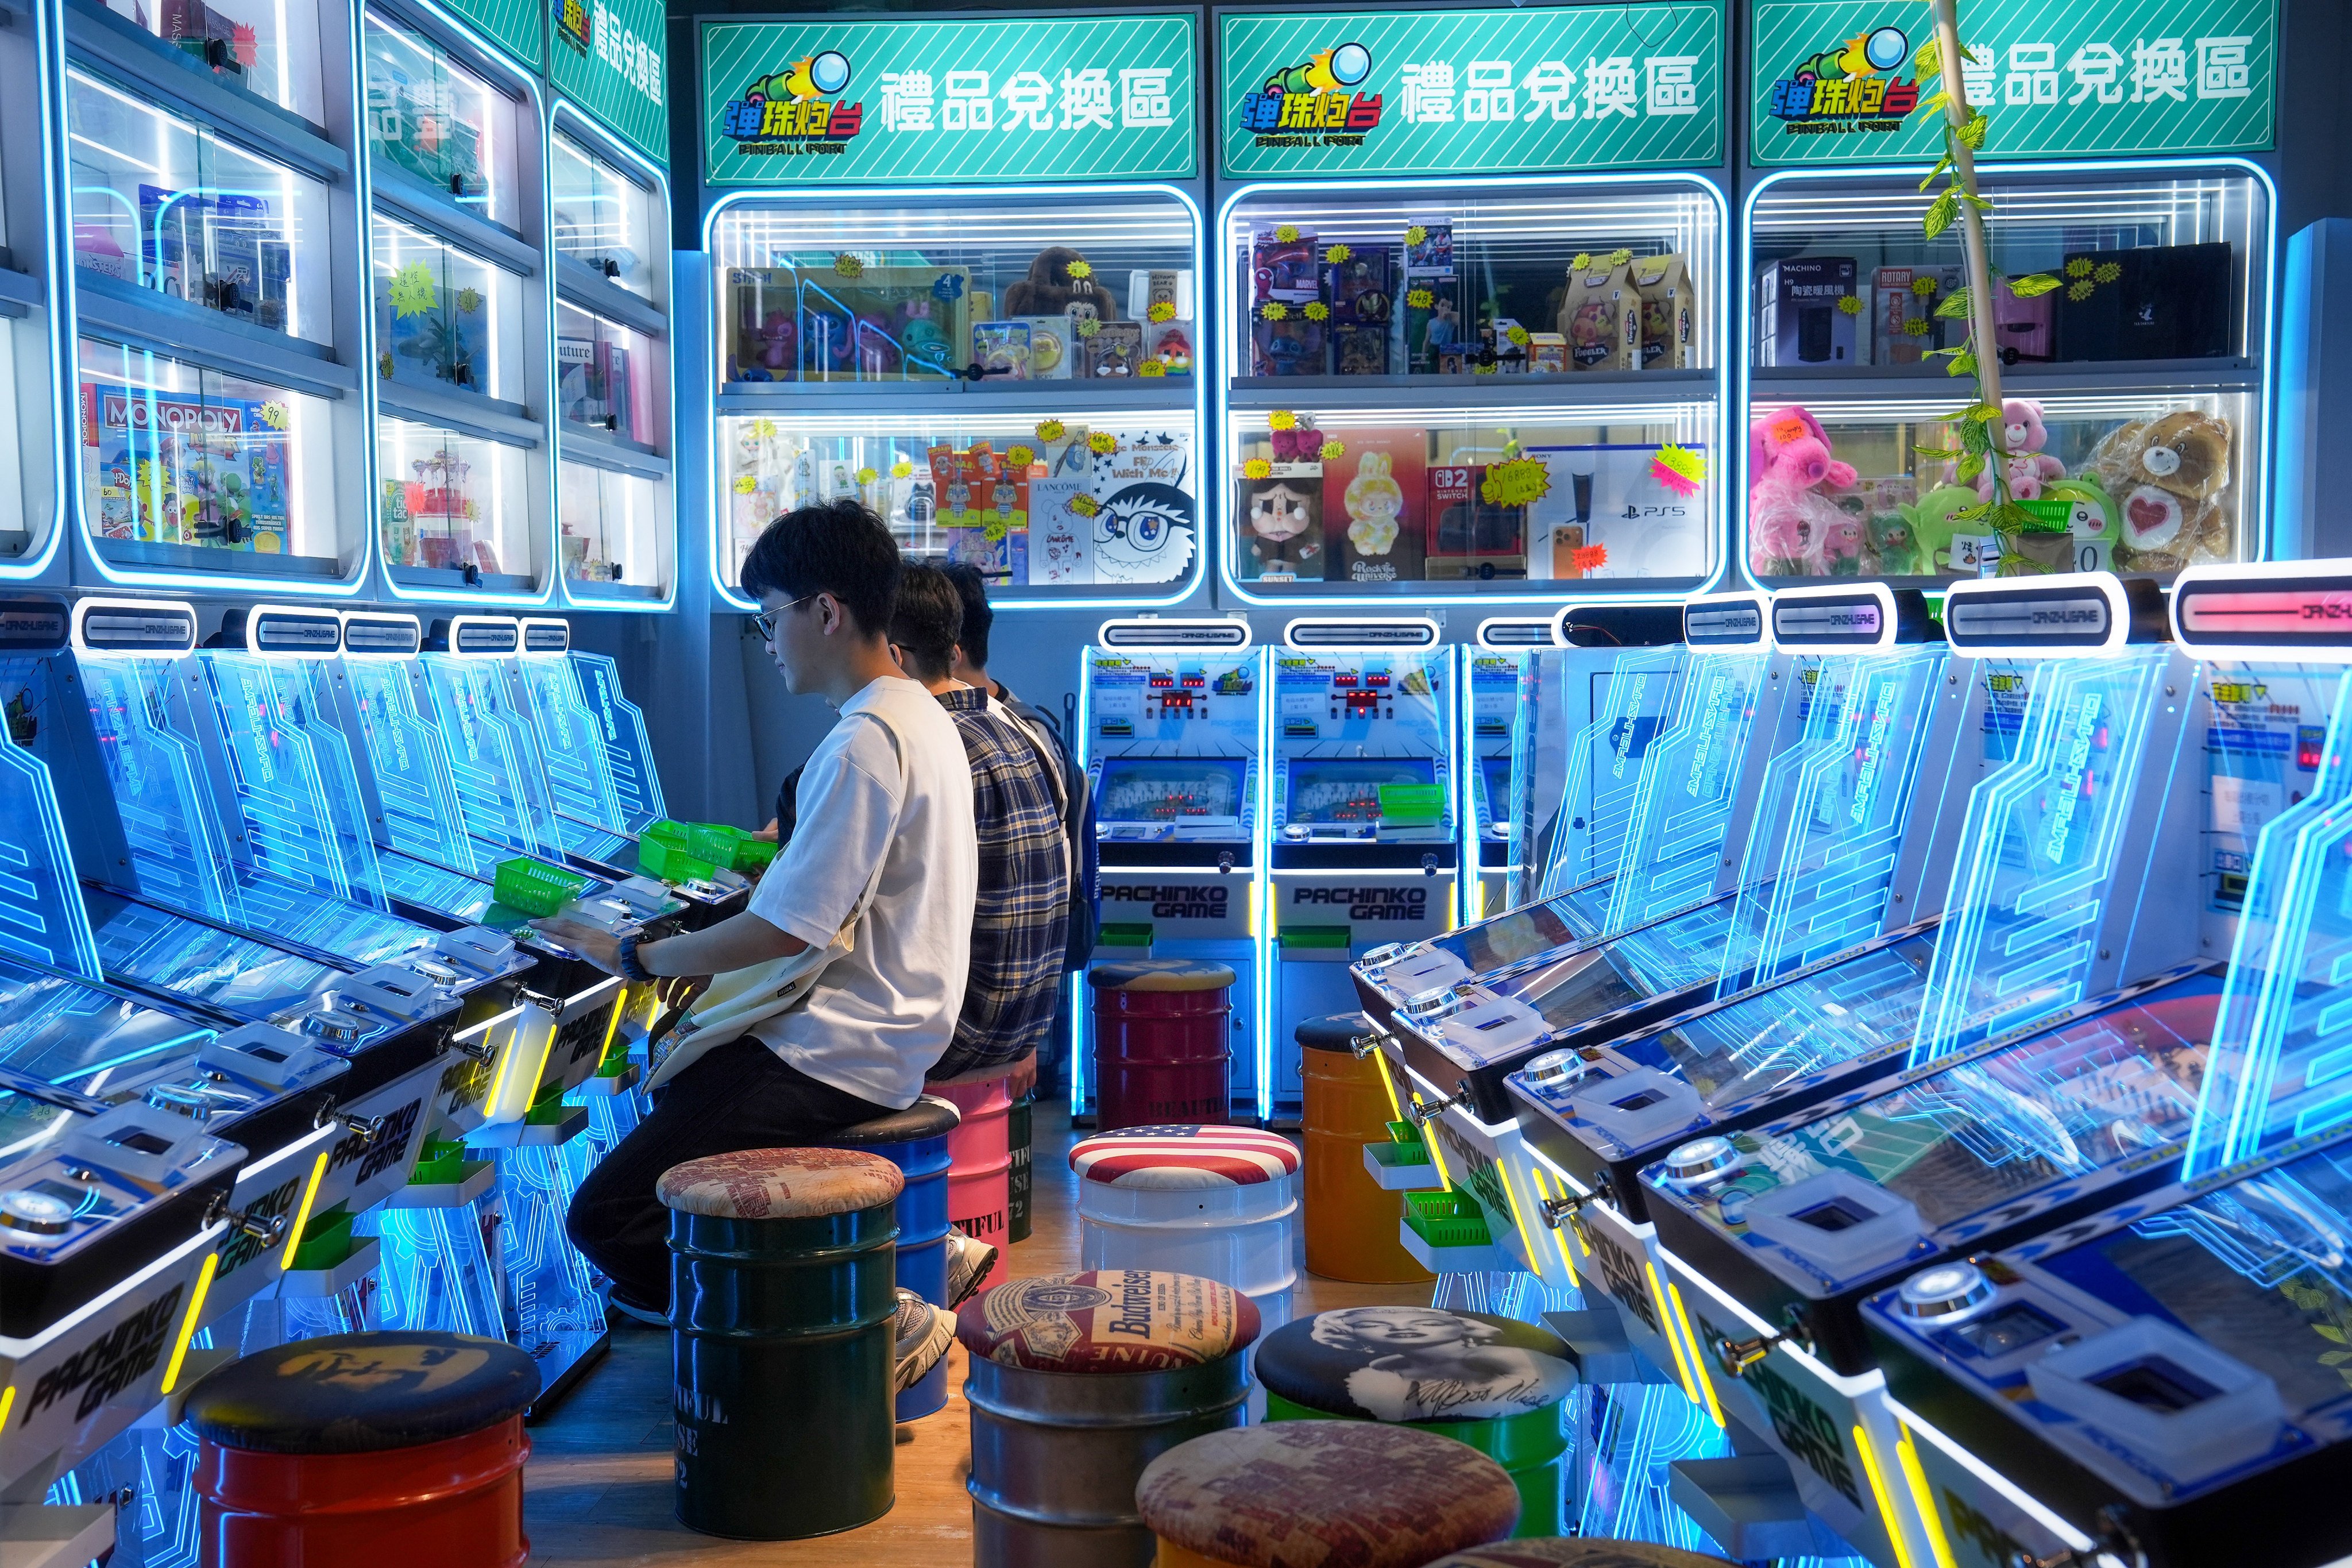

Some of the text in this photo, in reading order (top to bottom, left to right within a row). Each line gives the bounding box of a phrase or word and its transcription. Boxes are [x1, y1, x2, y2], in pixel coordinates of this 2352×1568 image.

[1400, 55, 1699, 123] 禮品兌換區
[881, 67, 1173, 133] 禮品兌換區
[1786, 119, 1903, 135] PINBALL FORT
[739, 142, 847, 156] PINBALL FORT
[1256, 134, 1366, 148] PINBALL FORT
[1880, 272, 1910, 282] ROTARY
[1410, 293, 1427, 304] 148
[1791, 284, 1845, 296] 陶瓷暖風機
[109, 400, 238, 433] MONOPOLY
[393, 508, 407, 519] tac
[1100, 885, 1228, 902] PACHINKO
[1293, 887, 1427, 905] PACHINKO
[1152, 902, 1227, 919] GAME
[1350, 903, 1427, 921] GAME
[356, 1128, 414, 1187] GAME
[1109, 1270, 1151, 1340] Budweiser
[21, 1282, 185, 1430] PACHINKO
[74, 1337, 166, 1425] GAME
